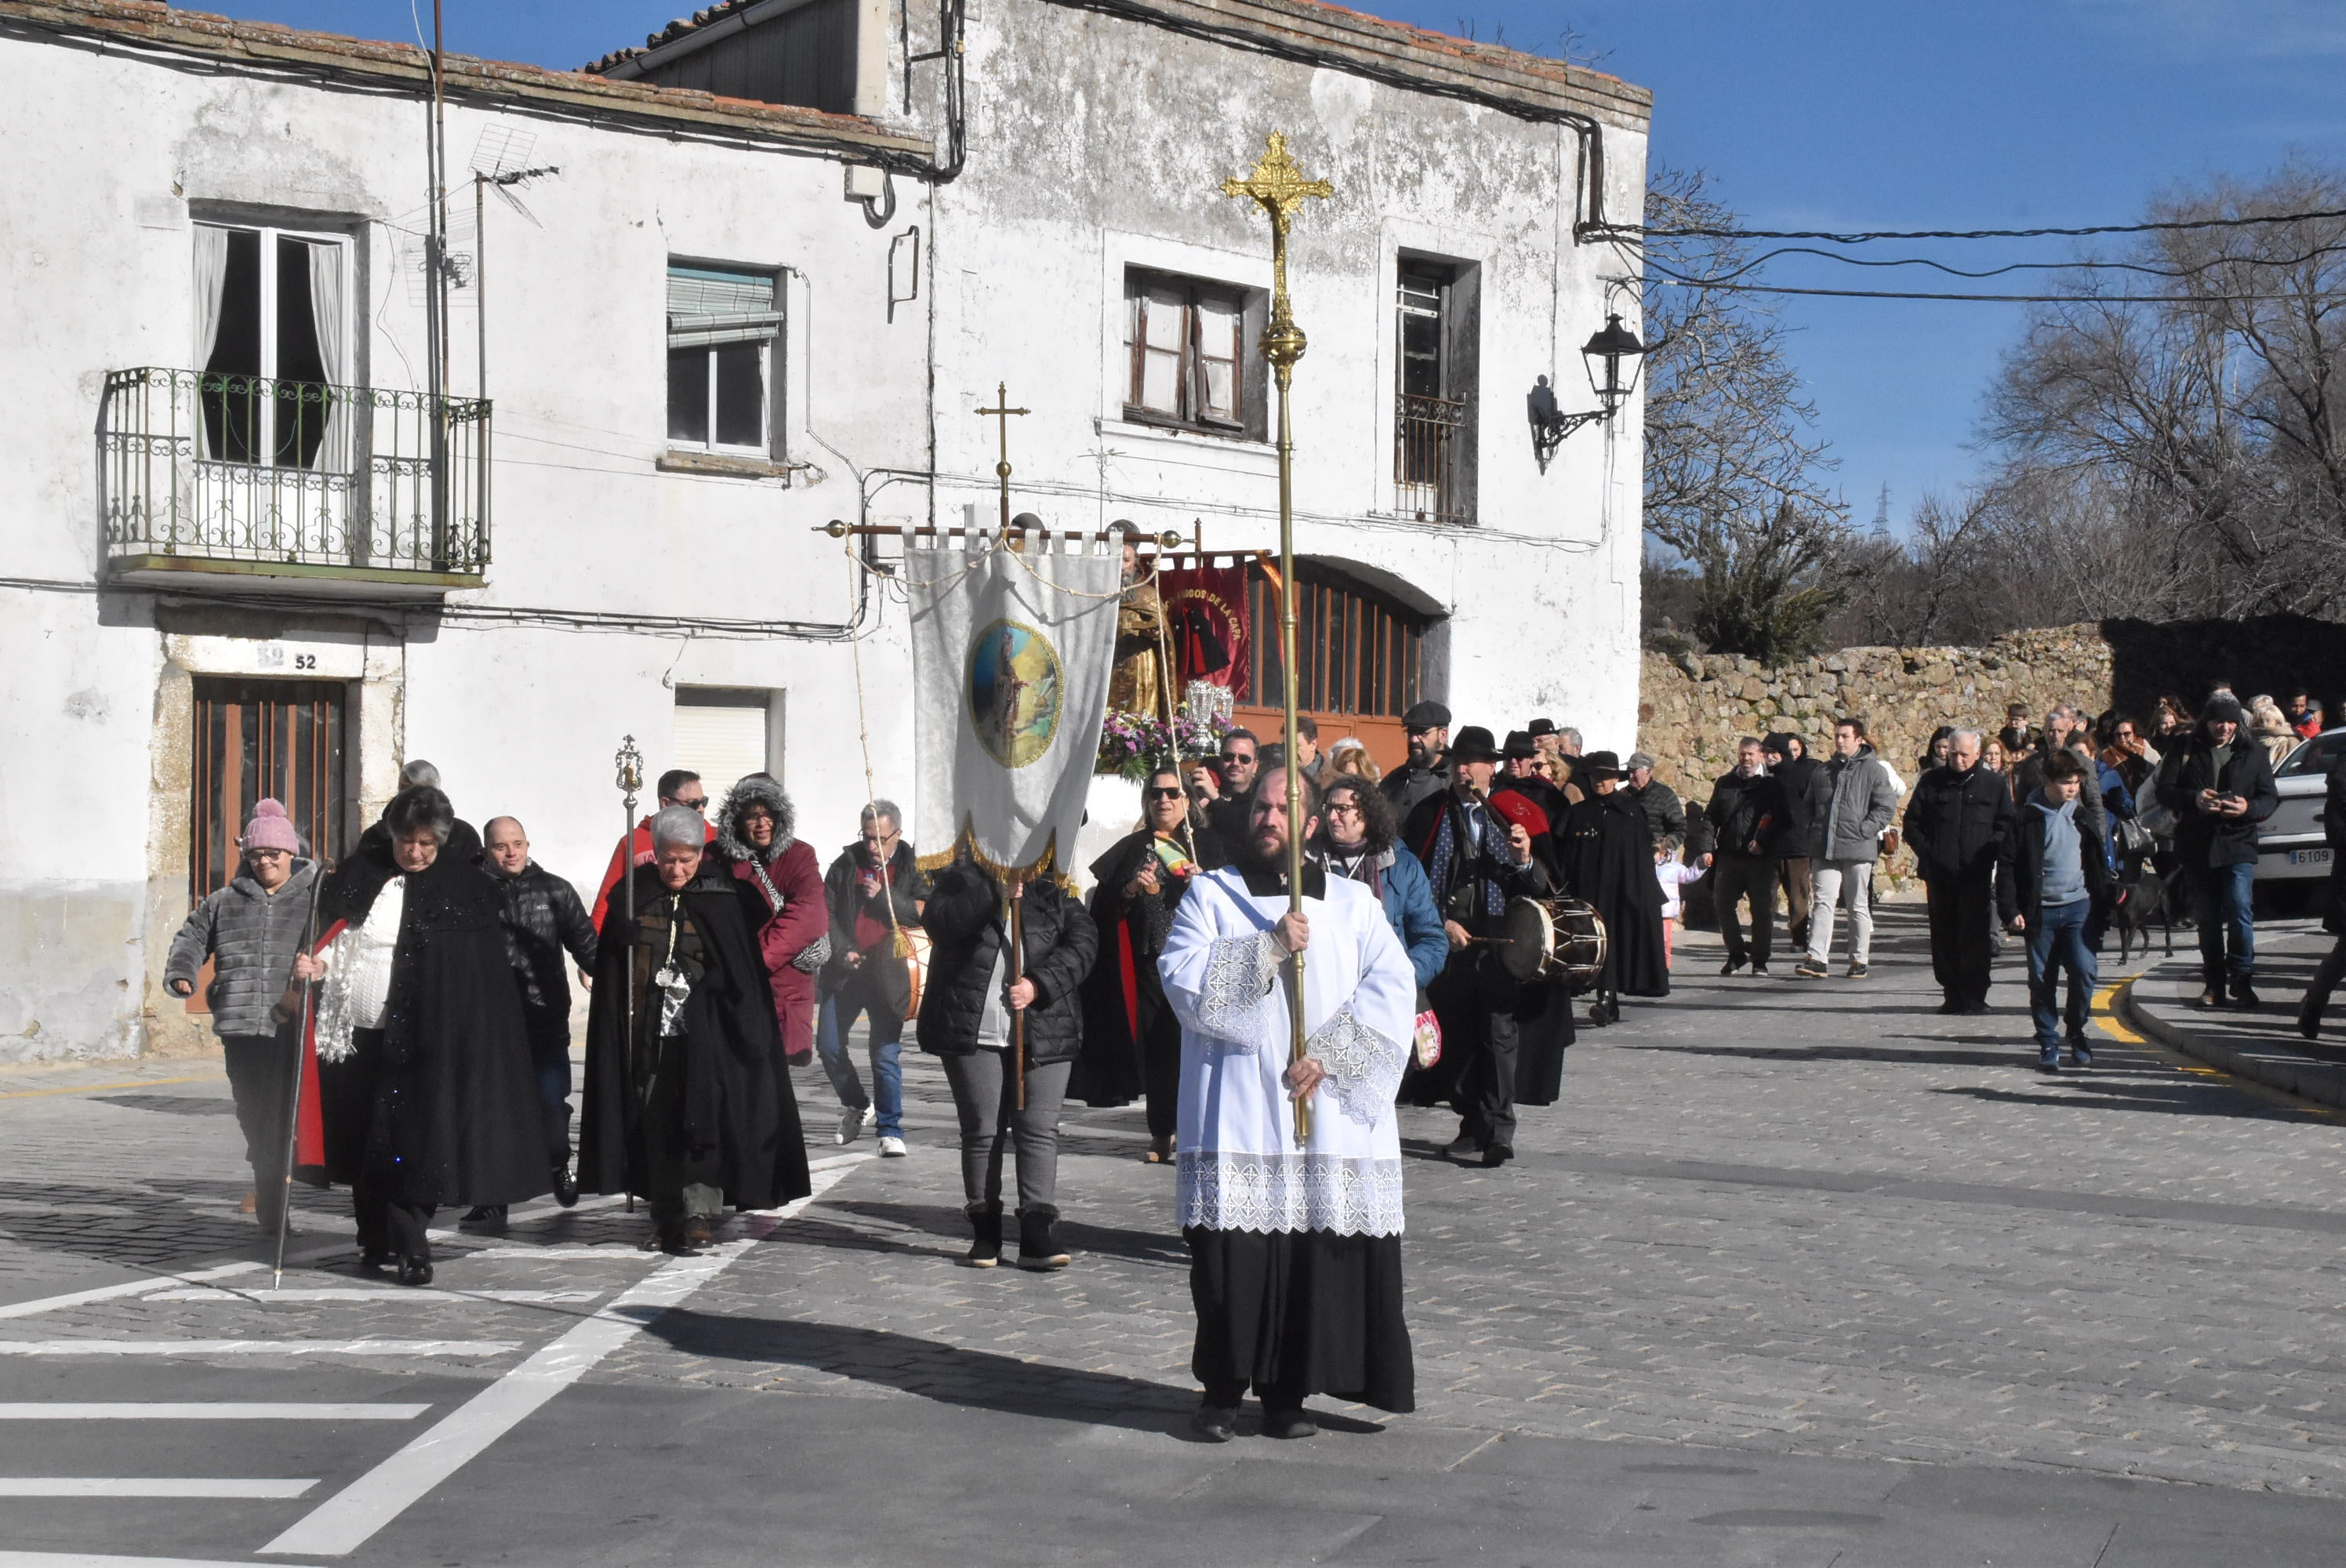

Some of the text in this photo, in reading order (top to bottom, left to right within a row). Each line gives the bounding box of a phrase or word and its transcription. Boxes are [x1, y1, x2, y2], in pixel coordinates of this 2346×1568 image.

[1208, 593, 1222, 606] DE
[1220, 603, 1232, 617] LA
[1229, 617, 1241, 641] CAPA
[295, 653, 316, 670] 52
[2298, 851, 2329, 864] 6109
